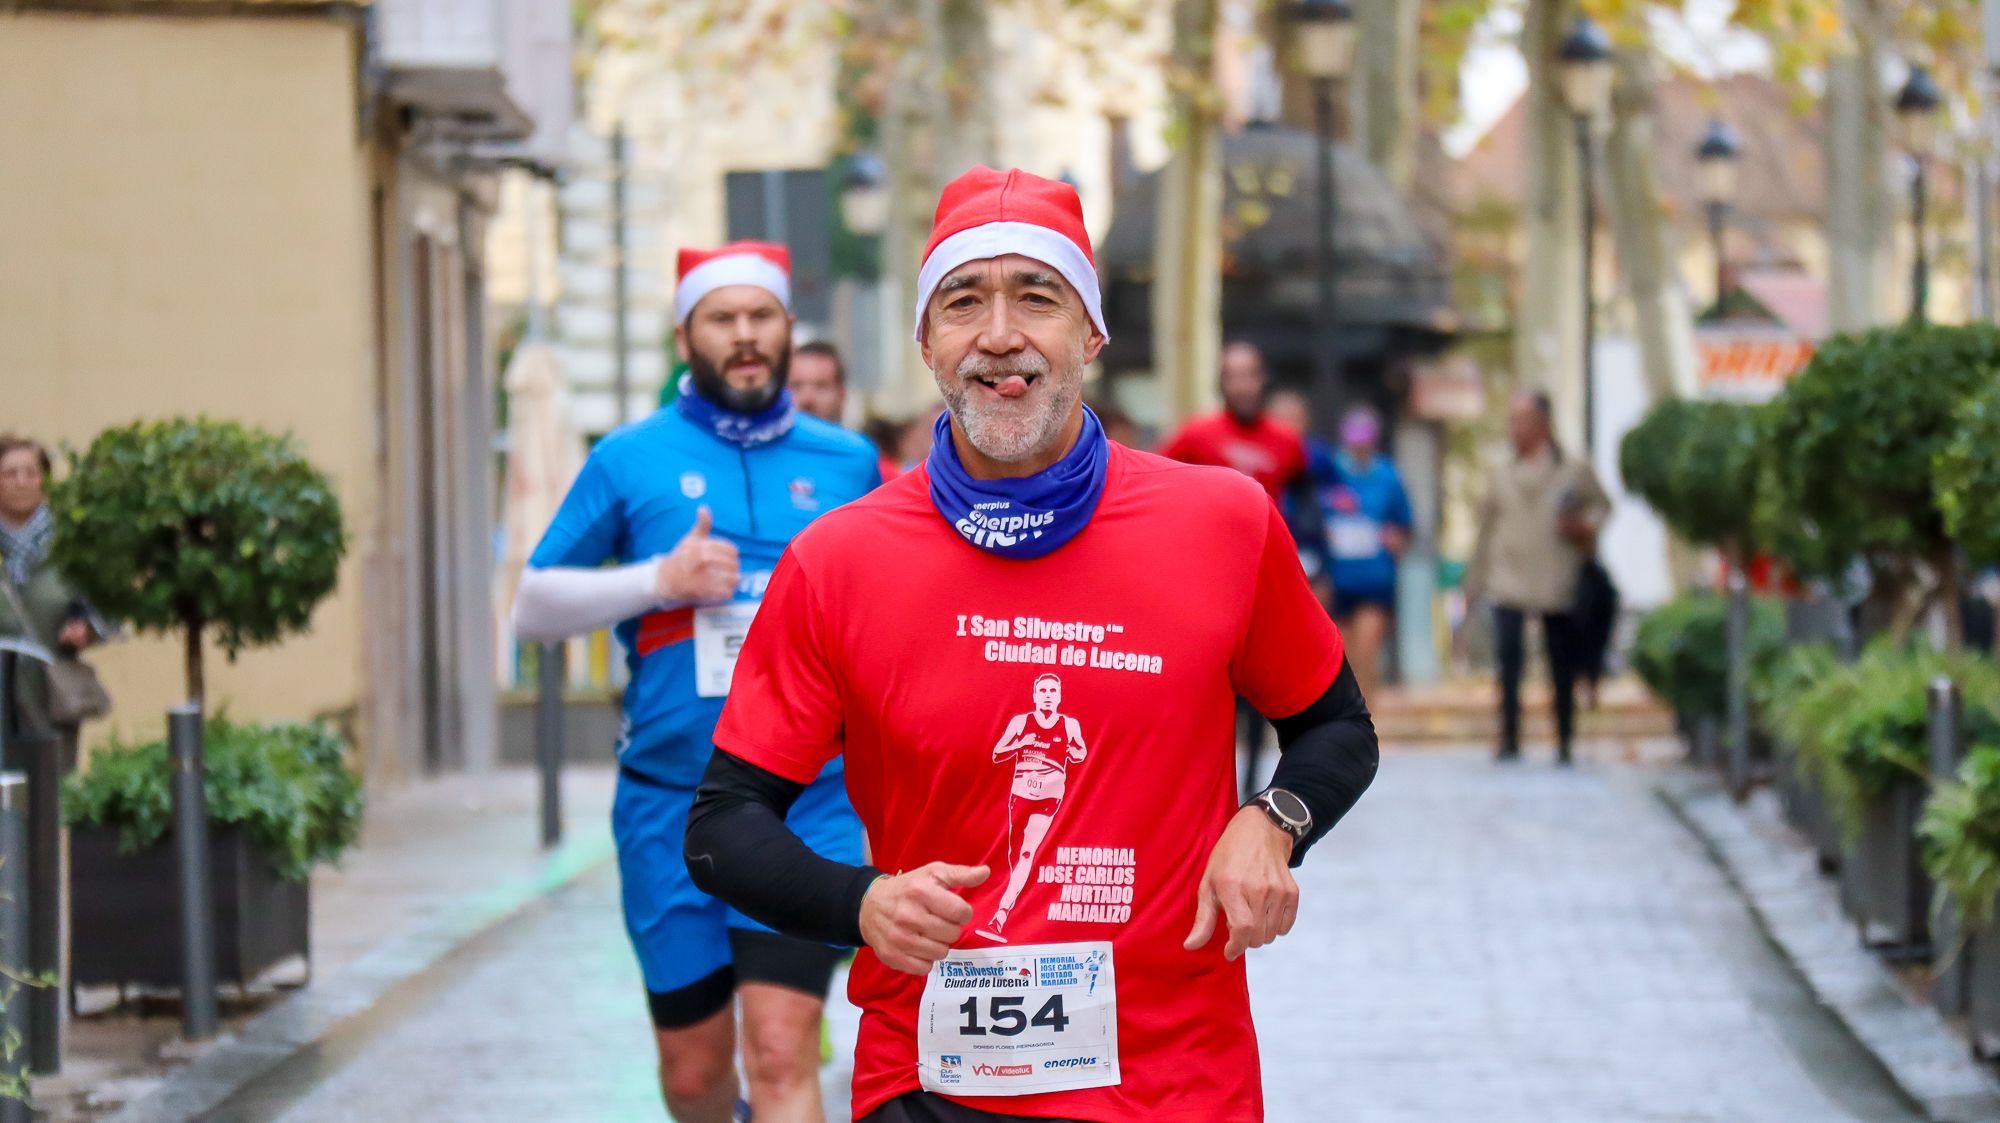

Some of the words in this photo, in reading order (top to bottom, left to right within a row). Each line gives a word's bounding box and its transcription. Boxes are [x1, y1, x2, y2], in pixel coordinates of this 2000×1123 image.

[969, 510, 1054, 533] enerplus
[956, 615, 967, 636] I
[970, 615, 1010, 637] San
[1013, 617, 1105, 643] Silvestre
[1112, 624, 1124, 633] km
[984, 640, 1058, 664] Ciudad
[1060, 644, 1087, 666] de
[1090, 647, 1163, 674] Lucena
[1027, 779, 1042, 789] 001
[1056, 847, 1136, 866] MEMORIAL
[1037, 866, 1074, 884] JOSE
[1075, 866, 1135, 885] CARLOS
[1060, 884, 1134, 904] HURTADO
[1048, 903, 1132, 923] MARJALIZO
[1040, 956, 1075, 964] MEMORIAL
[947, 966, 963, 976] San
[965, 966, 1004, 976] Silvestre
[944, 978, 978, 988] Ciudad
[978, 978, 990, 988] de
[992, 977, 1029, 988] Lucena
[960, 994, 1070, 1036] 154
[1044, 1056, 1097, 1068] enerplus
